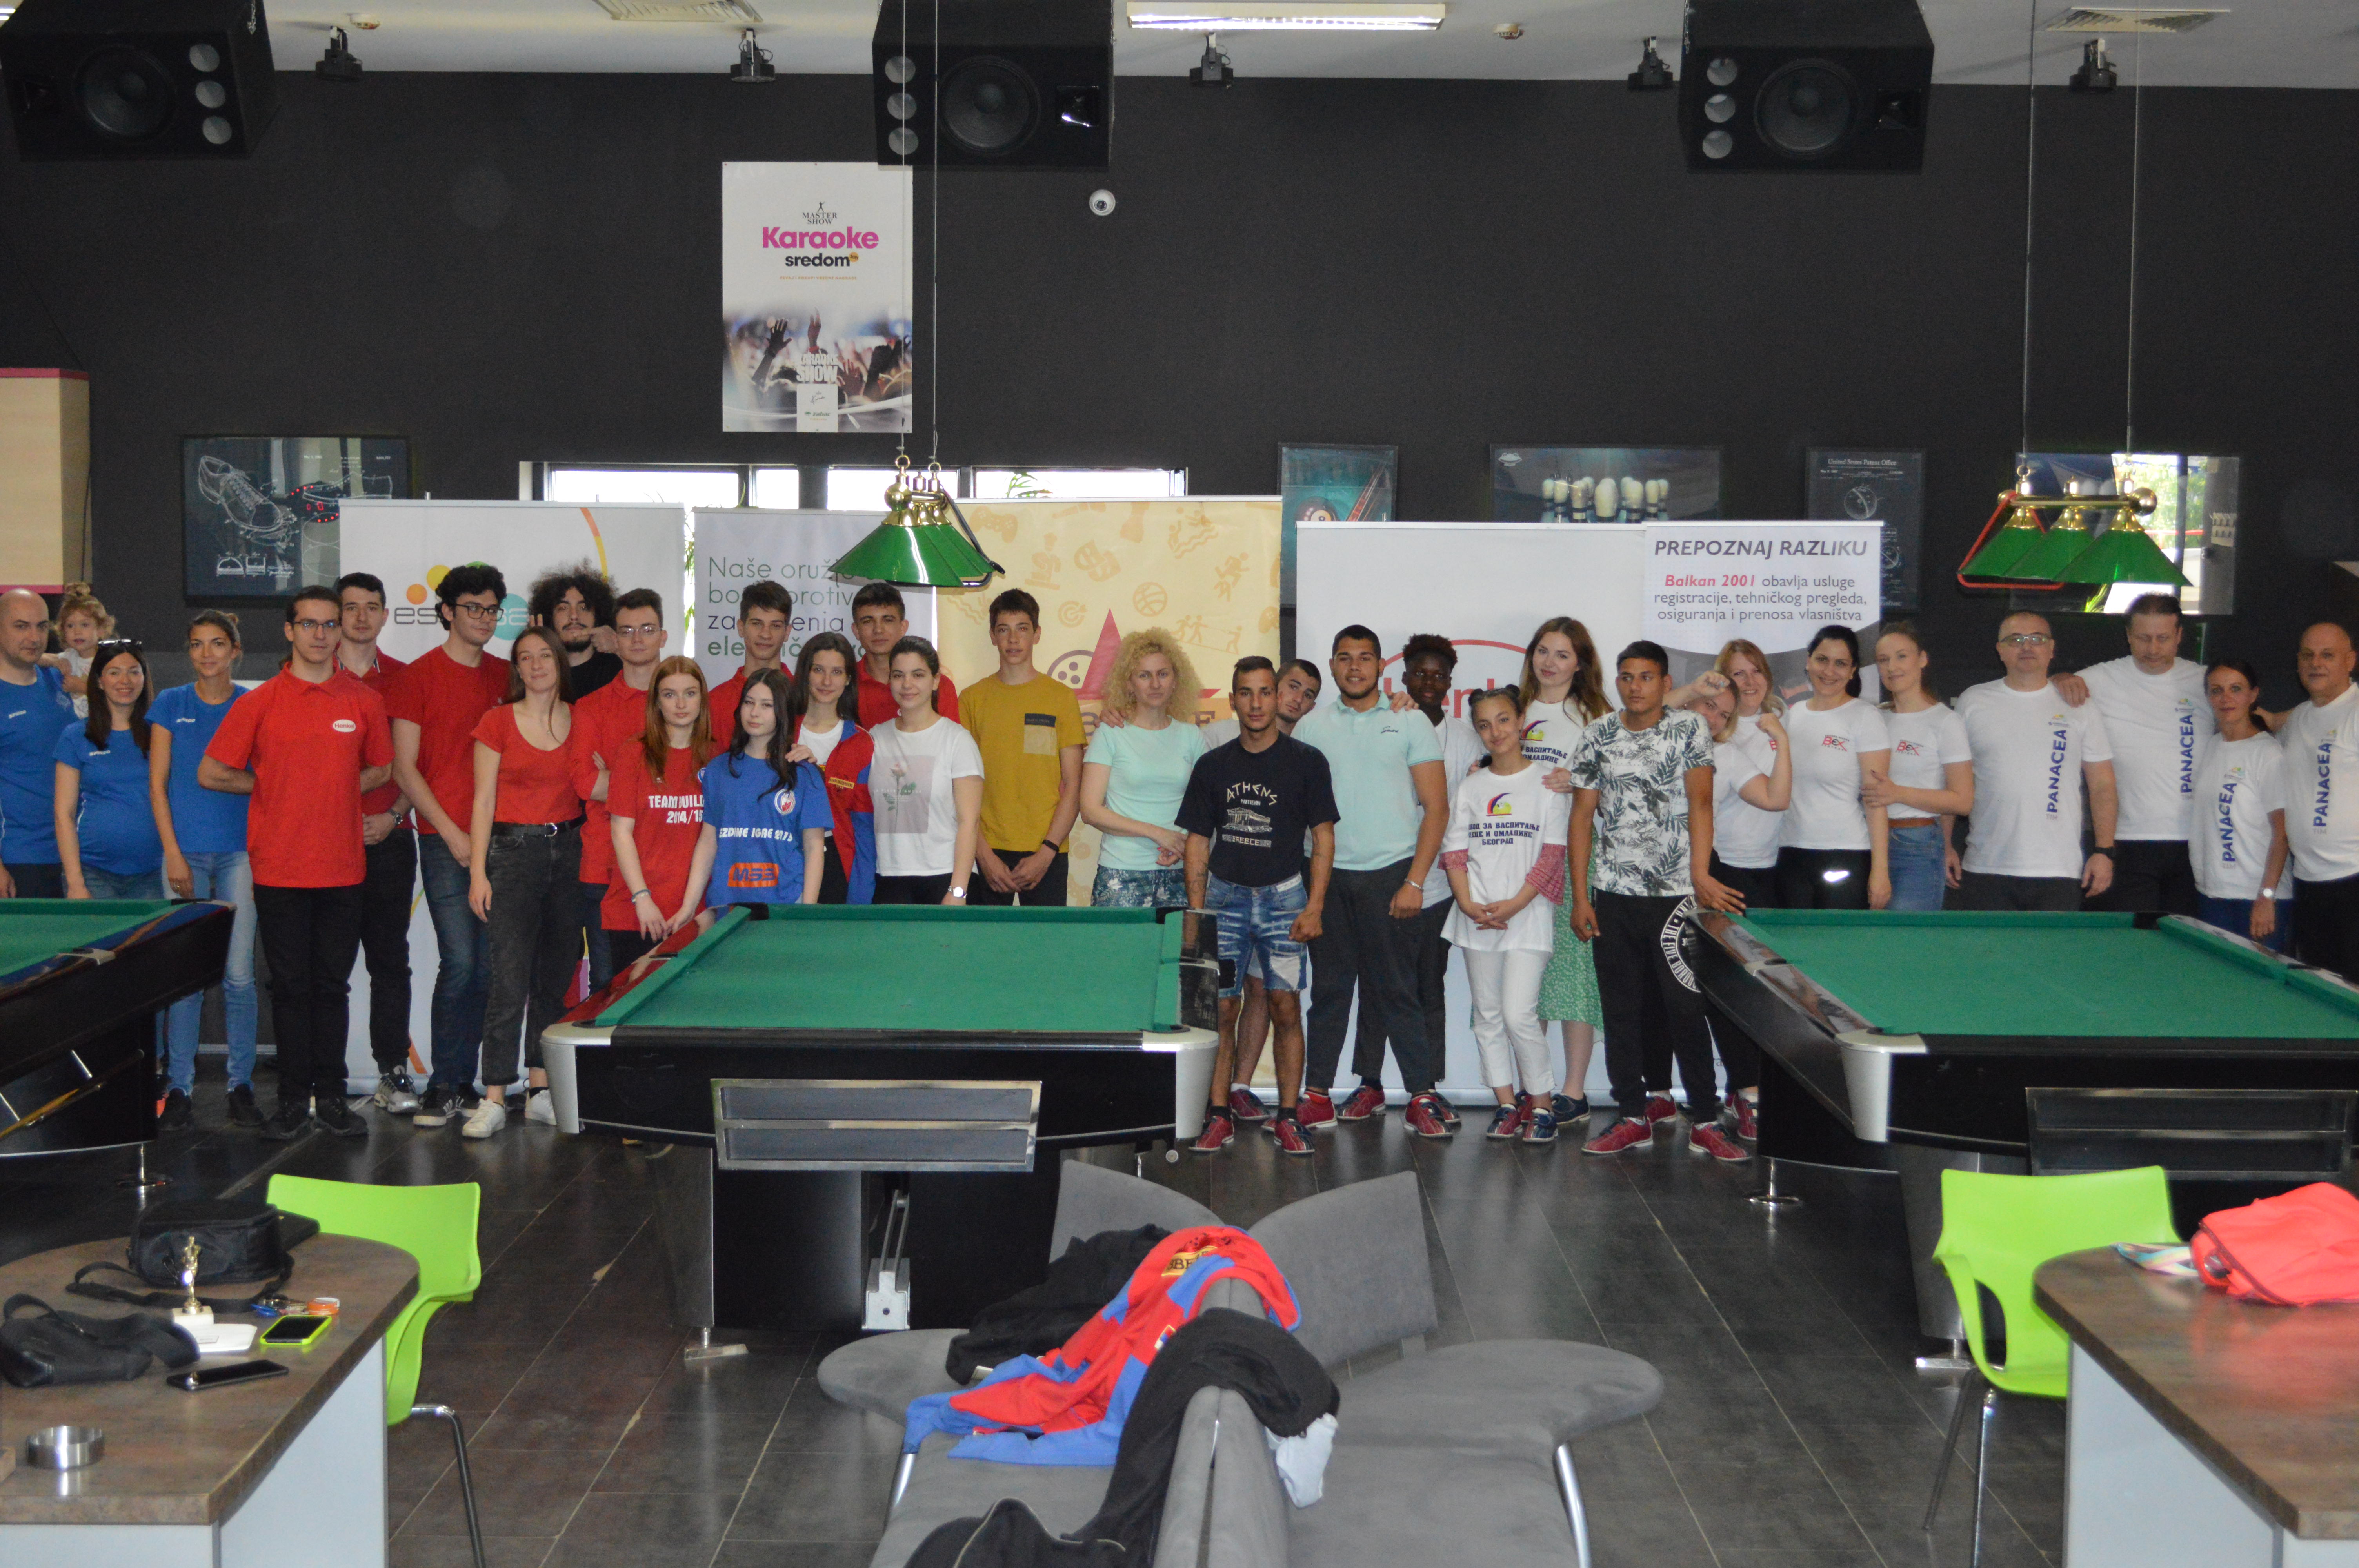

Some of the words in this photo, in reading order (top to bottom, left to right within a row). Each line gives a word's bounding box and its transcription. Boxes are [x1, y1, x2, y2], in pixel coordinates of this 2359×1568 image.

[763, 226, 879, 249] Karaoke
[785, 253, 850, 267] sredom
[1654, 540, 1773, 560] PREPOZNAJ
[1779, 541, 1867, 556] RAZLIKU
[709, 557, 771, 577] Naše
[1665, 574, 1716, 587] Balkan
[1721, 574, 1755, 587] 2001
[1762, 574, 1808, 590] obavlja
[1813, 575, 1855, 591] usluge
[1654, 591, 1732, 606] registracije,
[1736, 591, 1802, 607] tehničkog
[1807, 592, 1867, 607] pregleda,
[1657, 608, 1726, 623] osiguranja
[1731, 608, 1734, 620] i
[1740, 610, 1794, 623] prenosa
[1799, 608, 1862, 621] vlasništva
[1525, 746, 1568, 759] ВАСПИТАЊЕ
[2179, 714, 2194, 793] PANACEA
[2046, 730, 2066, 813] PANACEA
[1227, 781, 1277, 806] ATHENS
[2313, 743, 2332, 827] PANACEA
[1496, 822, 1540, 831] ВАСПИТАЊЕ
[2219, 783, 2237, 862] PANACEA
[751, 828, 773, 838] IGRE
[1232, 835, 1260, 846] GREECE
[1494, 830, 1533, 838] ОМЛАДИНЕ
[1663, 924, 1679, 940] THE
[1663, 942, 1678, 960] FIVE
